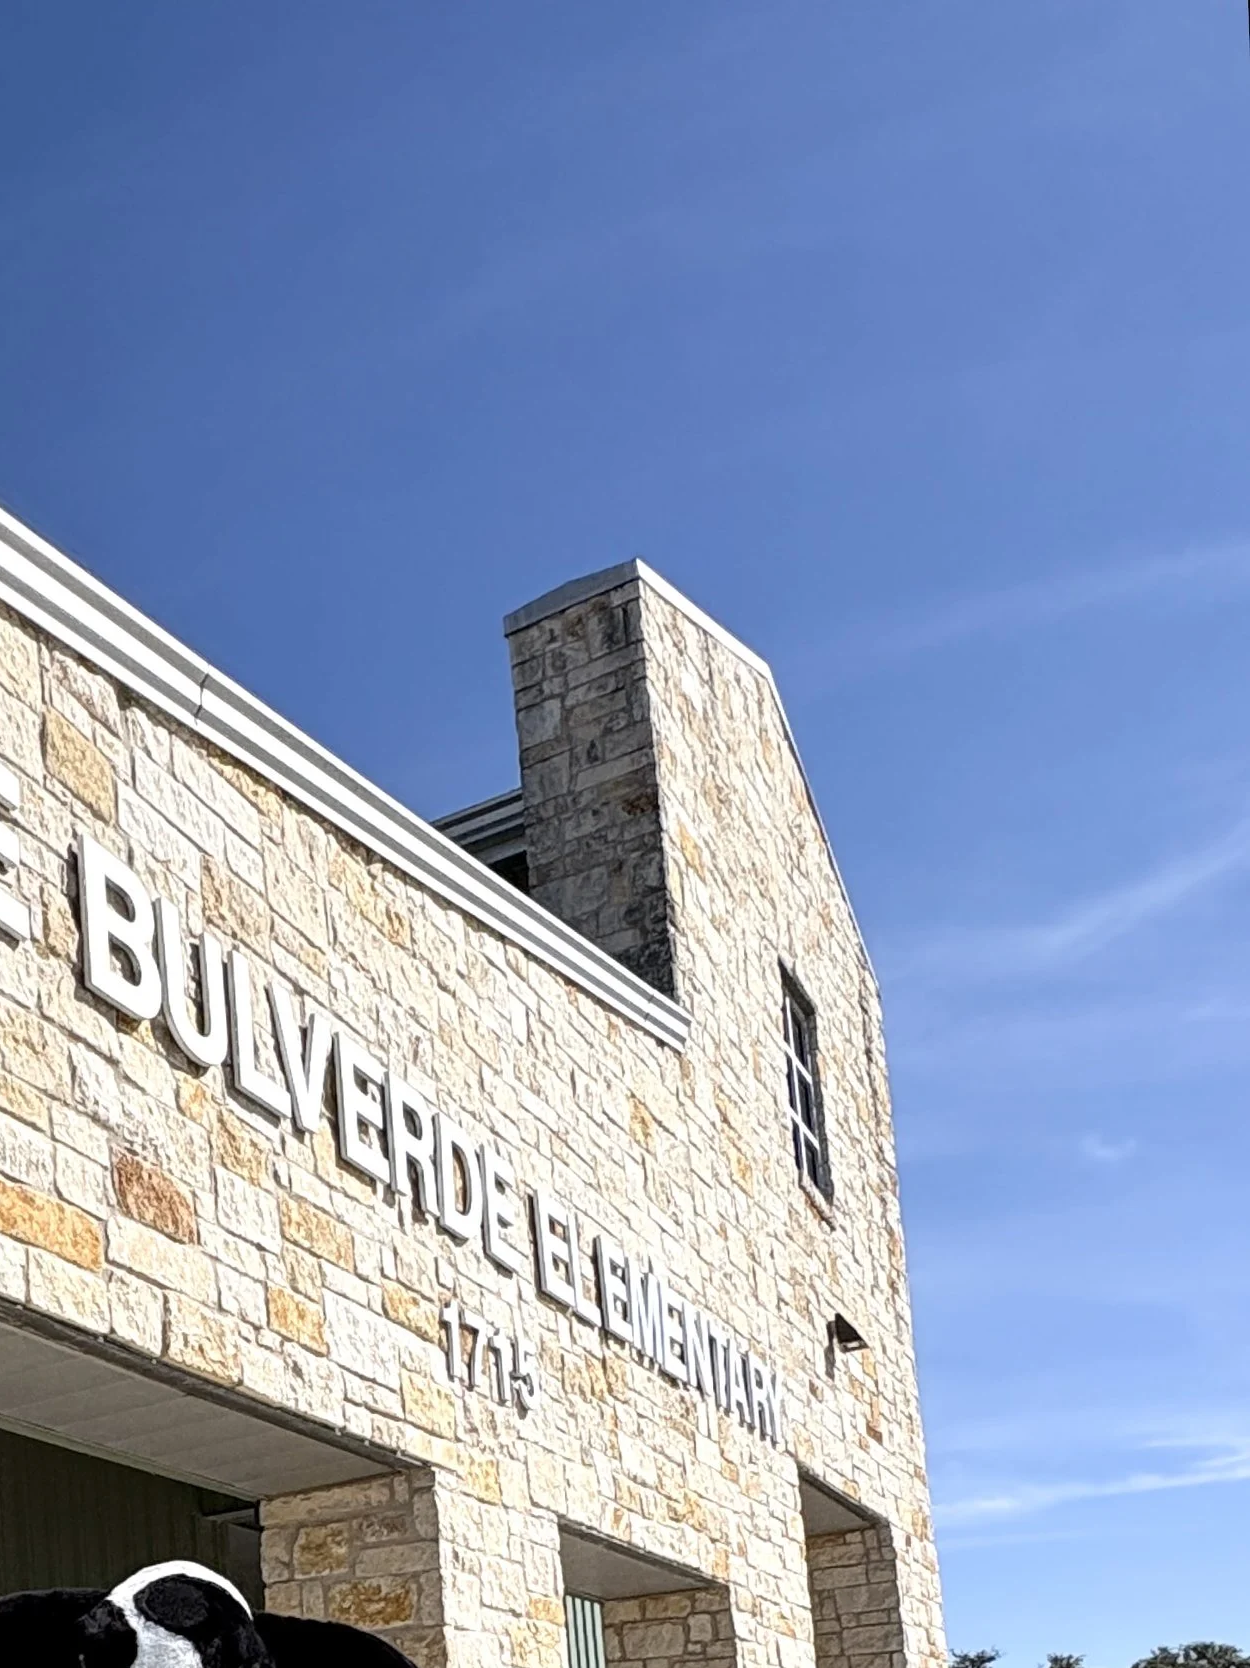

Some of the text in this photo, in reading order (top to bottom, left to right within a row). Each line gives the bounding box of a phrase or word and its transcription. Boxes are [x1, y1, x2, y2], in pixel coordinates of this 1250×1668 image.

[76, 833, 532, 1275] BULVERDE
[533, 1186, 786, 1447] ELEMENTARY
[440, 1300, 541, 1412] 1715
